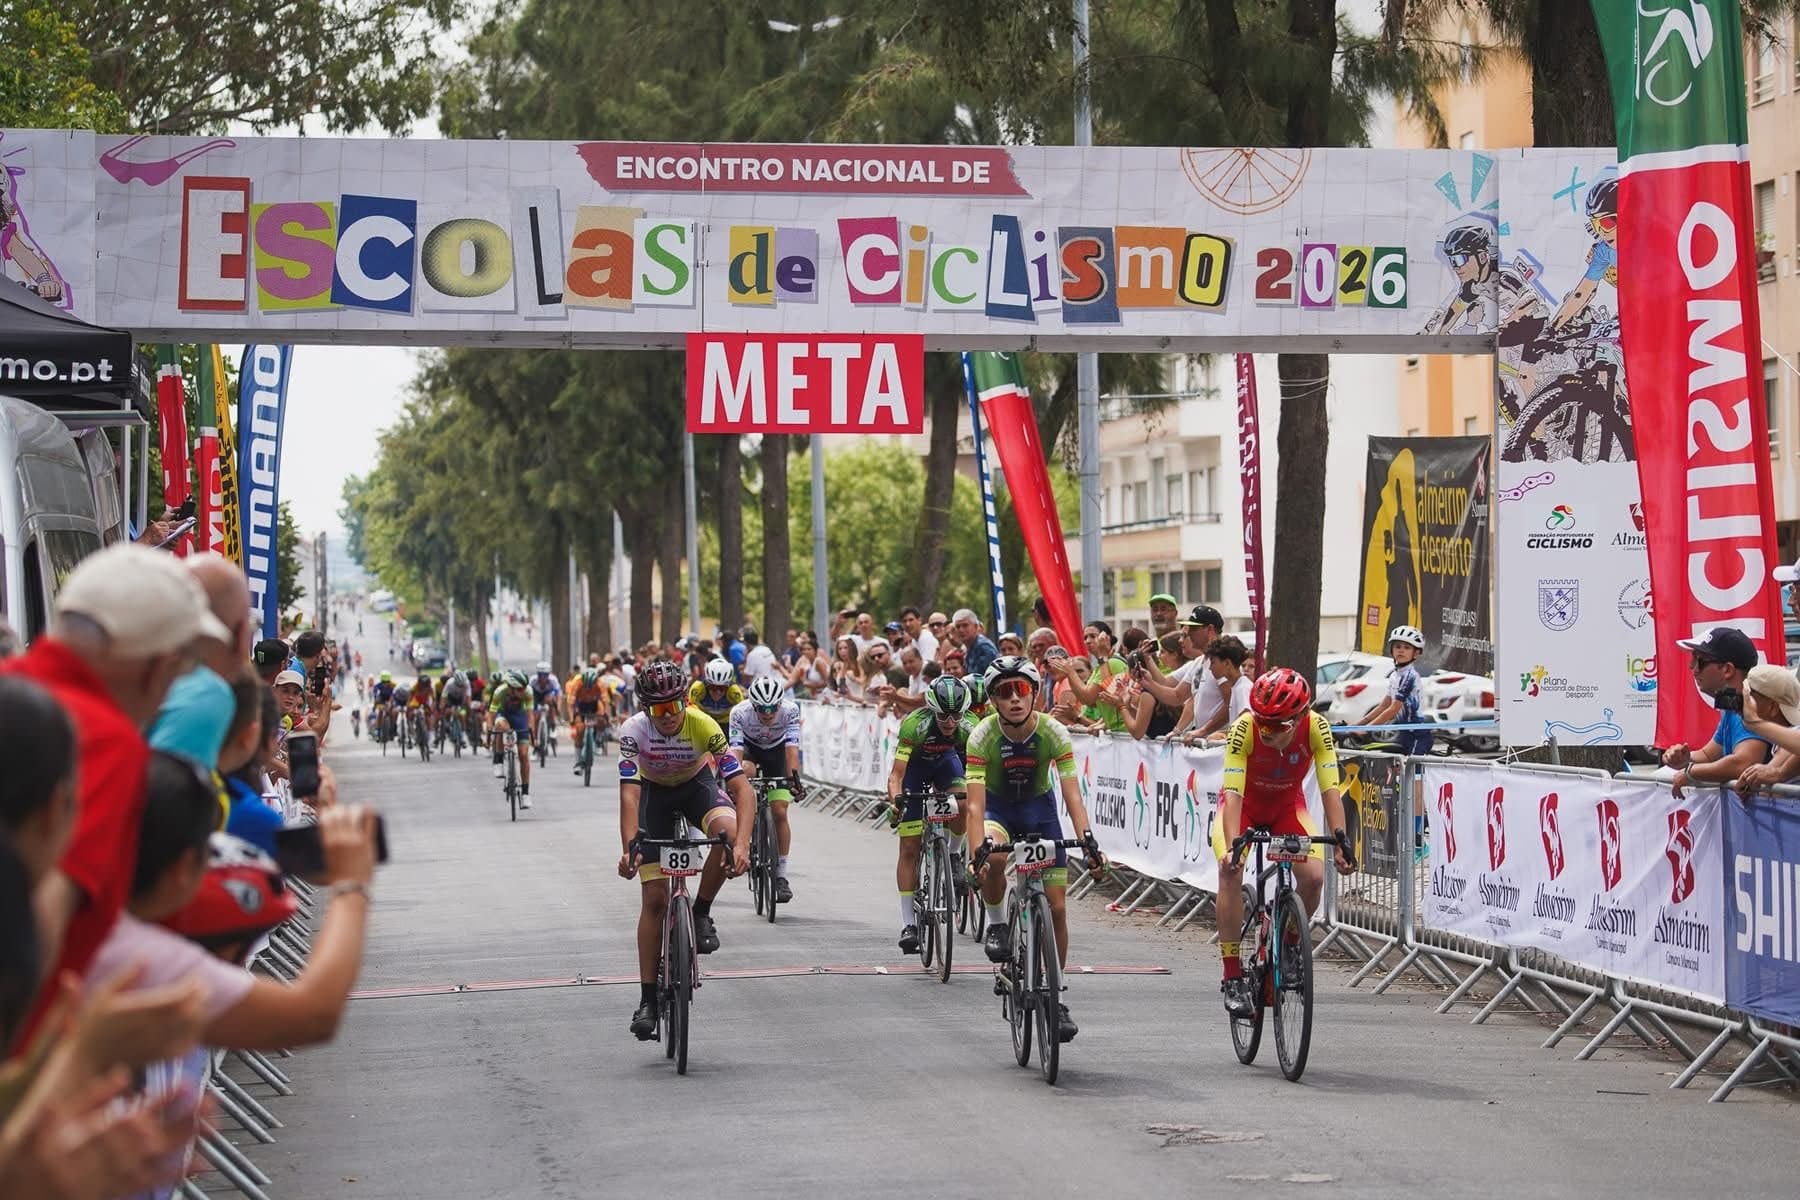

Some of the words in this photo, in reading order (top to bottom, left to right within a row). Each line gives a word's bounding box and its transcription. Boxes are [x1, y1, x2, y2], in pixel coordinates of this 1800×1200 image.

[615, 156, 785, 182] ENCONTRO
[792, 158, 945, 183] NACIONAL
[952, 160, 991, 184] DE
[728, 231, 816, 296] de
[1255, 247, 1408, 306] 2026
[700, 340, 910, 426] META
[248, 343, 283, 660] HIMANO
[1417, 469, 1469, 526] almeirim
[1420, 527, 1473, 589] desporto
[1526, 537, 1593, 549] CICLISMO
[1610, 532, 1646, 546] Alme
[1543, 677, 1568, 686] Plano
[933, 802, 952, 815] 22
[1095, 792, 1126, 829] CICLISMO
[1155, 782, 1179, 841] FPC
[668, 852, 690, 869] 89
[1023, 844, 1047, 864] 20
[1479, 871, 1520, 912] Almeirim
[1533, 882, 1576, 924] Almeirim
[1735, 854, 1800, 963] SHI
[1654, 904, 1710, 953] Almeirim
